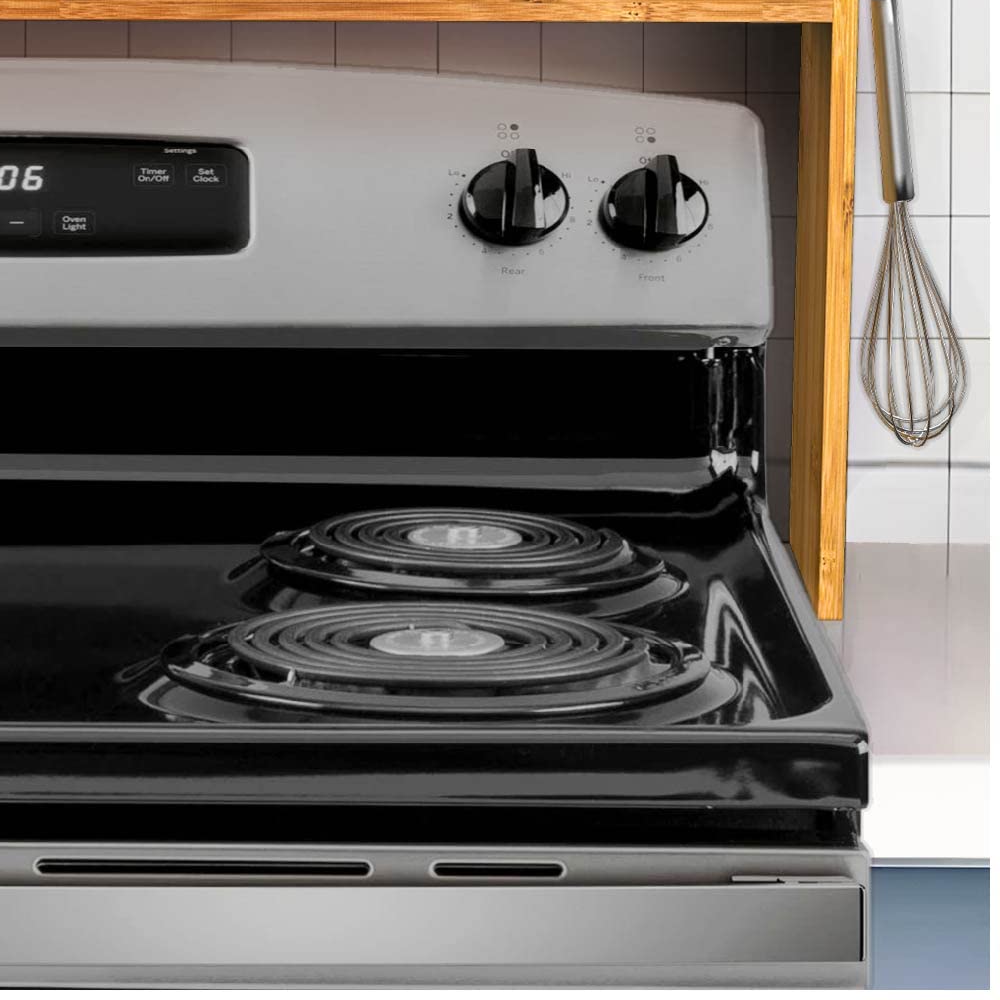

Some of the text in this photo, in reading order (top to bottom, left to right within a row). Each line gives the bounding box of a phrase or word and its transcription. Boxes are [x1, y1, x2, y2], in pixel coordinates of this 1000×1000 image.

[140, 167, 167, 175] Timer
[197, 167, 215, 175] Set
[137, 175, 170, 183] On/Off
[193, 175, 219, 183] Clock
[62, 223, 87, 231] Light
[501, 267, 525, 275] Rear
[638, 274, 665, 282] Front
